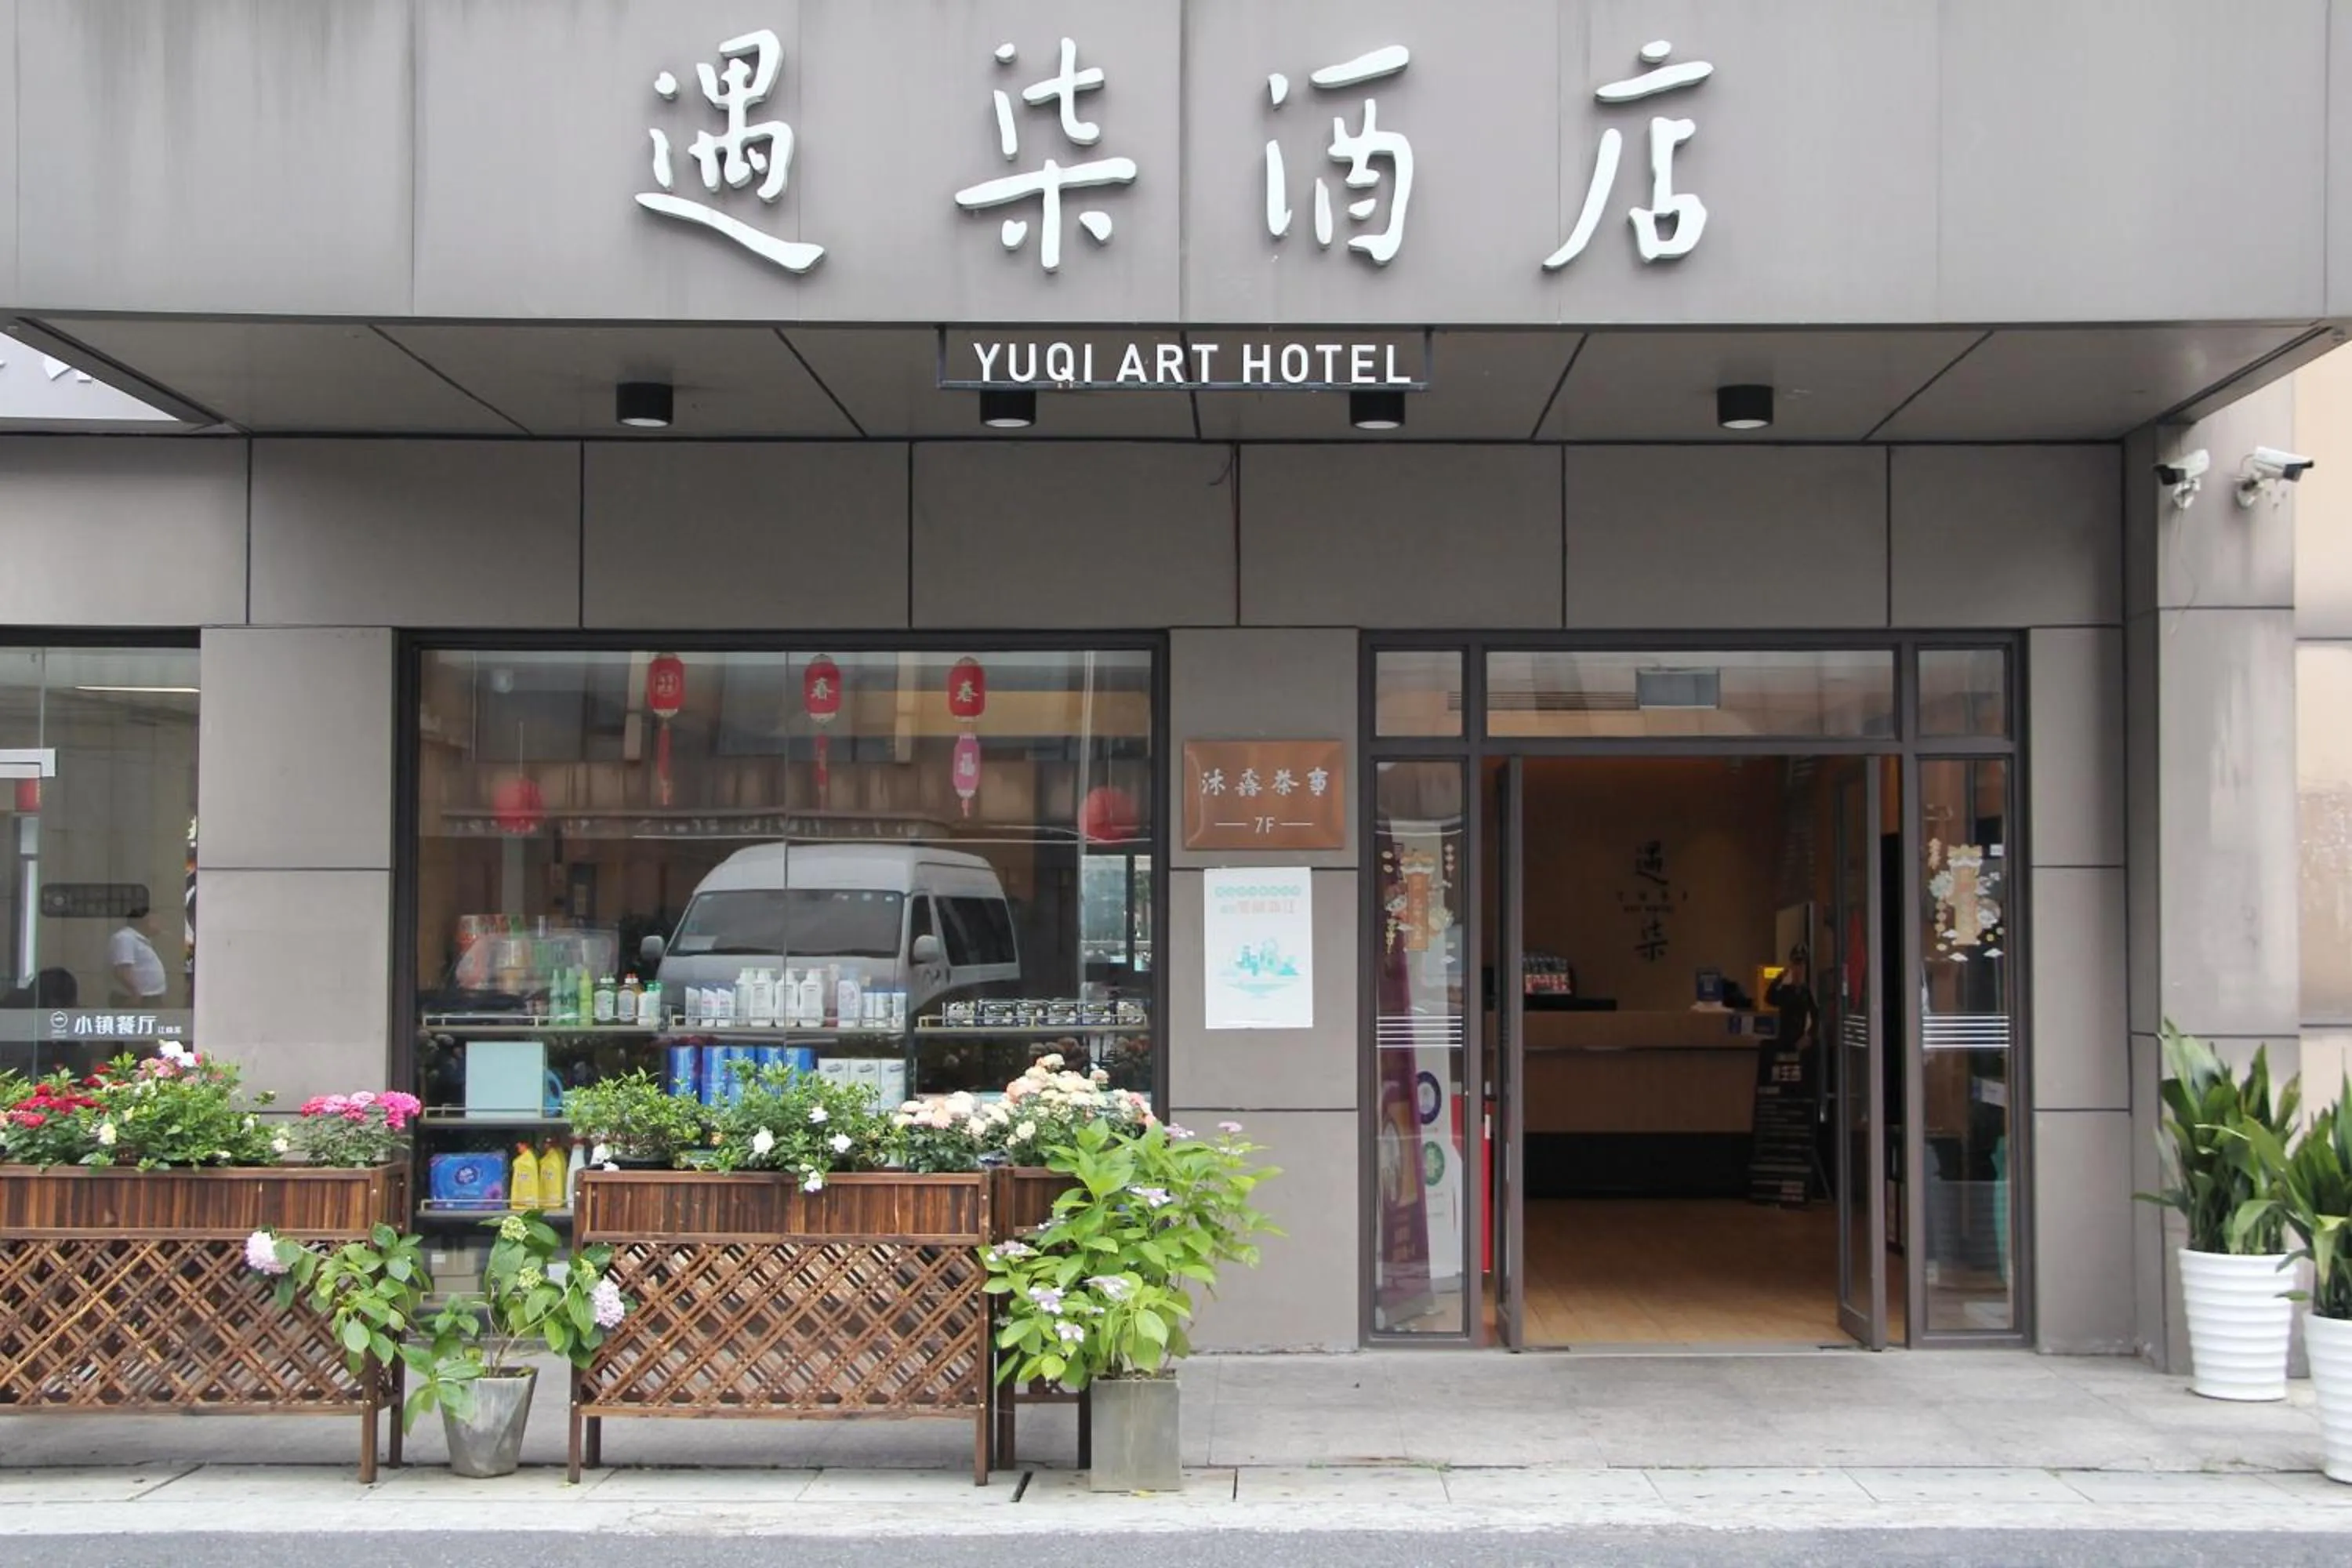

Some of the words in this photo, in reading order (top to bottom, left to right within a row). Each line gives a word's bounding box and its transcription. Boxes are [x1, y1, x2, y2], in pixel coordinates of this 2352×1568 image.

[634, 28, 1714, 274] 遇柒酒店
[973, 342, 1093, 383] YUQI
[1116, 343, 1219, 383] ART
[1243, 343, 1411, 383] HOTEL
[1254, 816, 1276, 834] 7F
[74, 1015, 158, 1035] 小镇餐厅
